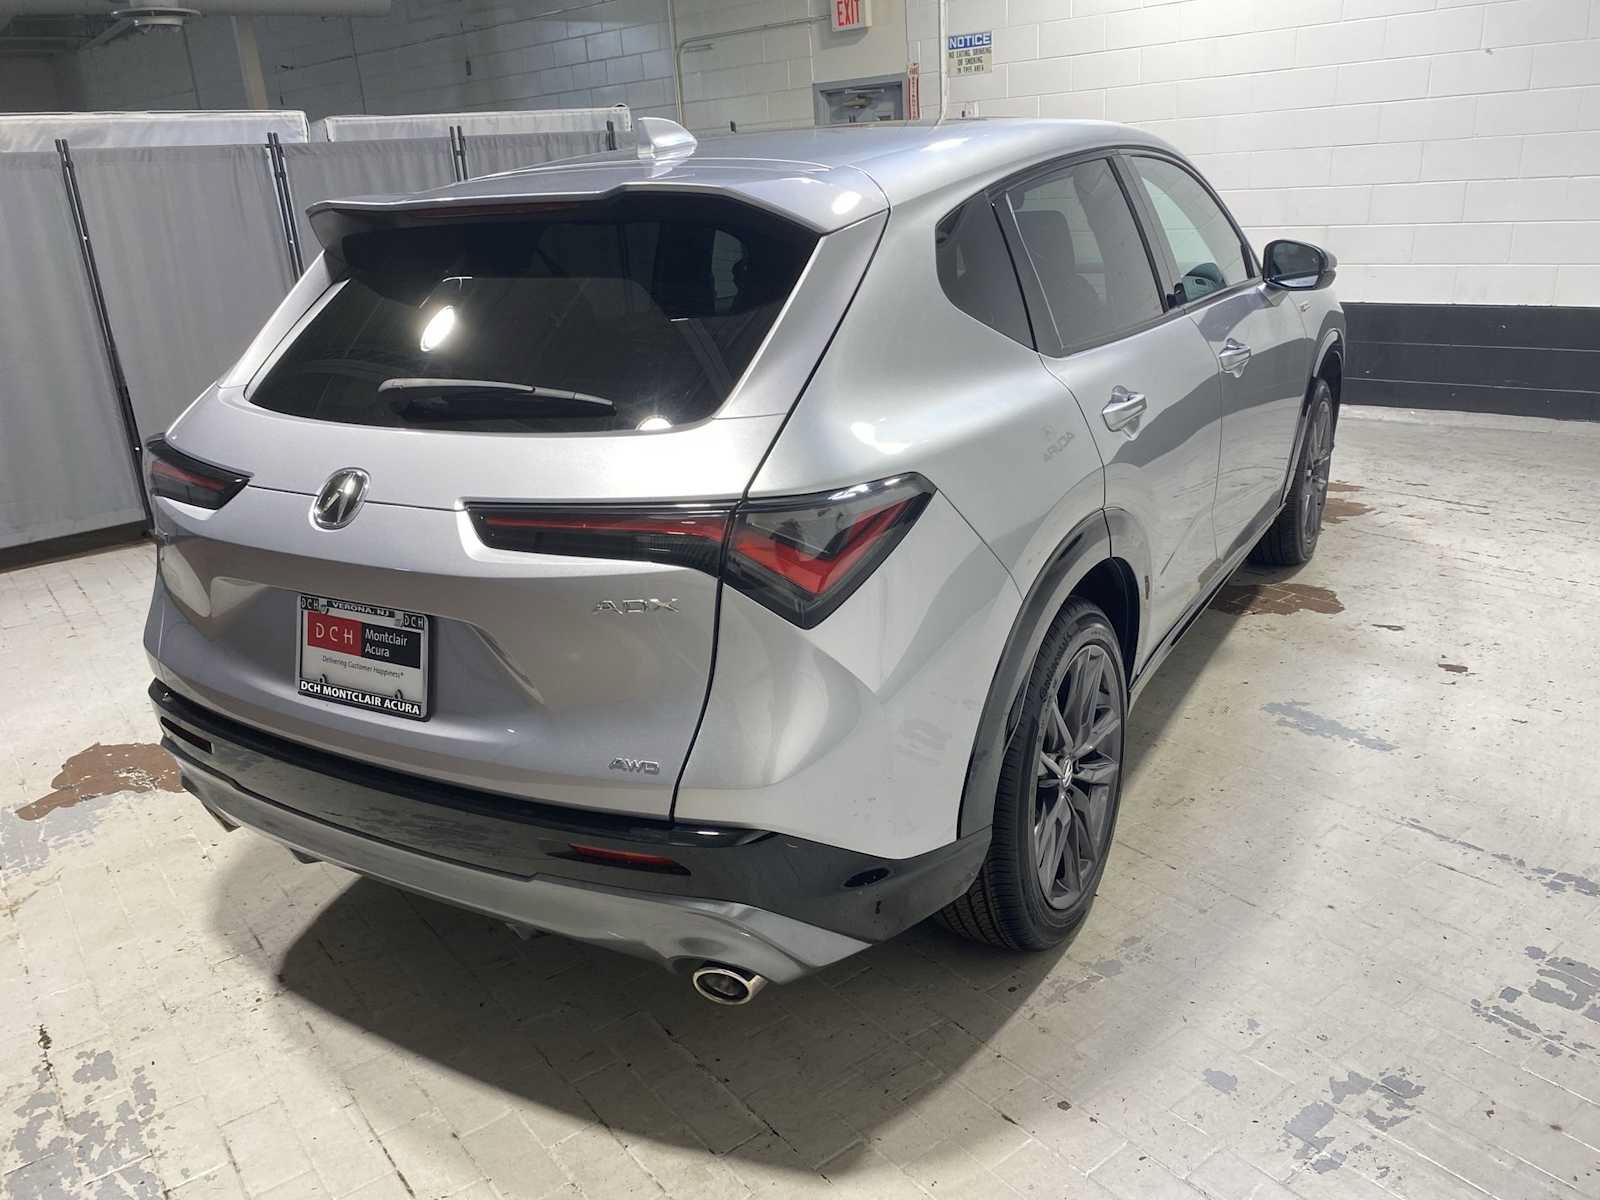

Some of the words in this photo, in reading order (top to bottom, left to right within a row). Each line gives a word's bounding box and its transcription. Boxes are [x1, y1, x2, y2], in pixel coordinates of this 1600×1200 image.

[836, 0, 860, 26] EXIT
[949, 33, 991, 49] NOTICE
[301, 597, 320, 610] DCH
[376, 607, 390, 617] NJ
[593, 598, 679, 615] ADX
[403, 614, 424, 629] DCH
[315, 622, 353, 646] DCH
[365, 628, 408, 647] Montclair
[365, 643, 390, 657] Acura
[322, 655, 348, 669] Delivering
[348, 661, 373, 673] Customer
[300, 680, 321, 694] DCH
[322, 685, 382, 707] MONTCLAIR
[383, 699, 420, 715] ACURA
[608, 757, 660, 775] AWD
